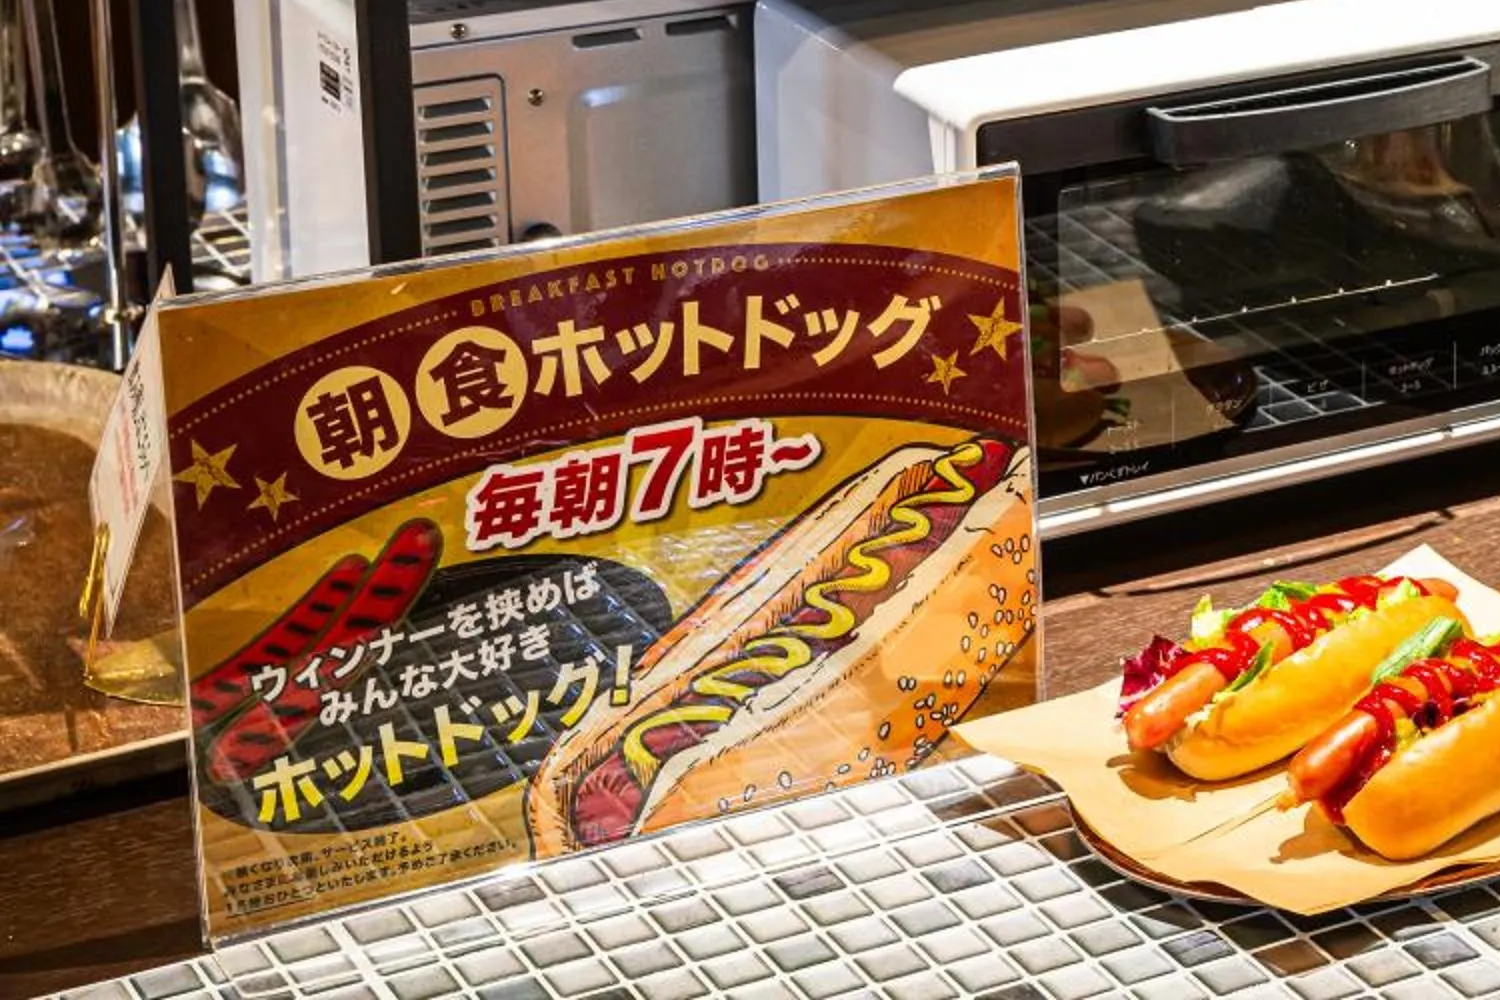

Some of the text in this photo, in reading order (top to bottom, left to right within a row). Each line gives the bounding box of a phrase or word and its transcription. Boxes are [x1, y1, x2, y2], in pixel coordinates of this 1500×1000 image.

[469, 255, 770, 317] BREAKFAST HOTDOG
[298, 293, 942, 477] 朝食ホットドッグ
[251, 559, 601, 705] ウィンナーを挟めば
[318, 624, 553, 727] みんな大好き
[252, 645, 636, 828] ホットドッグ!
